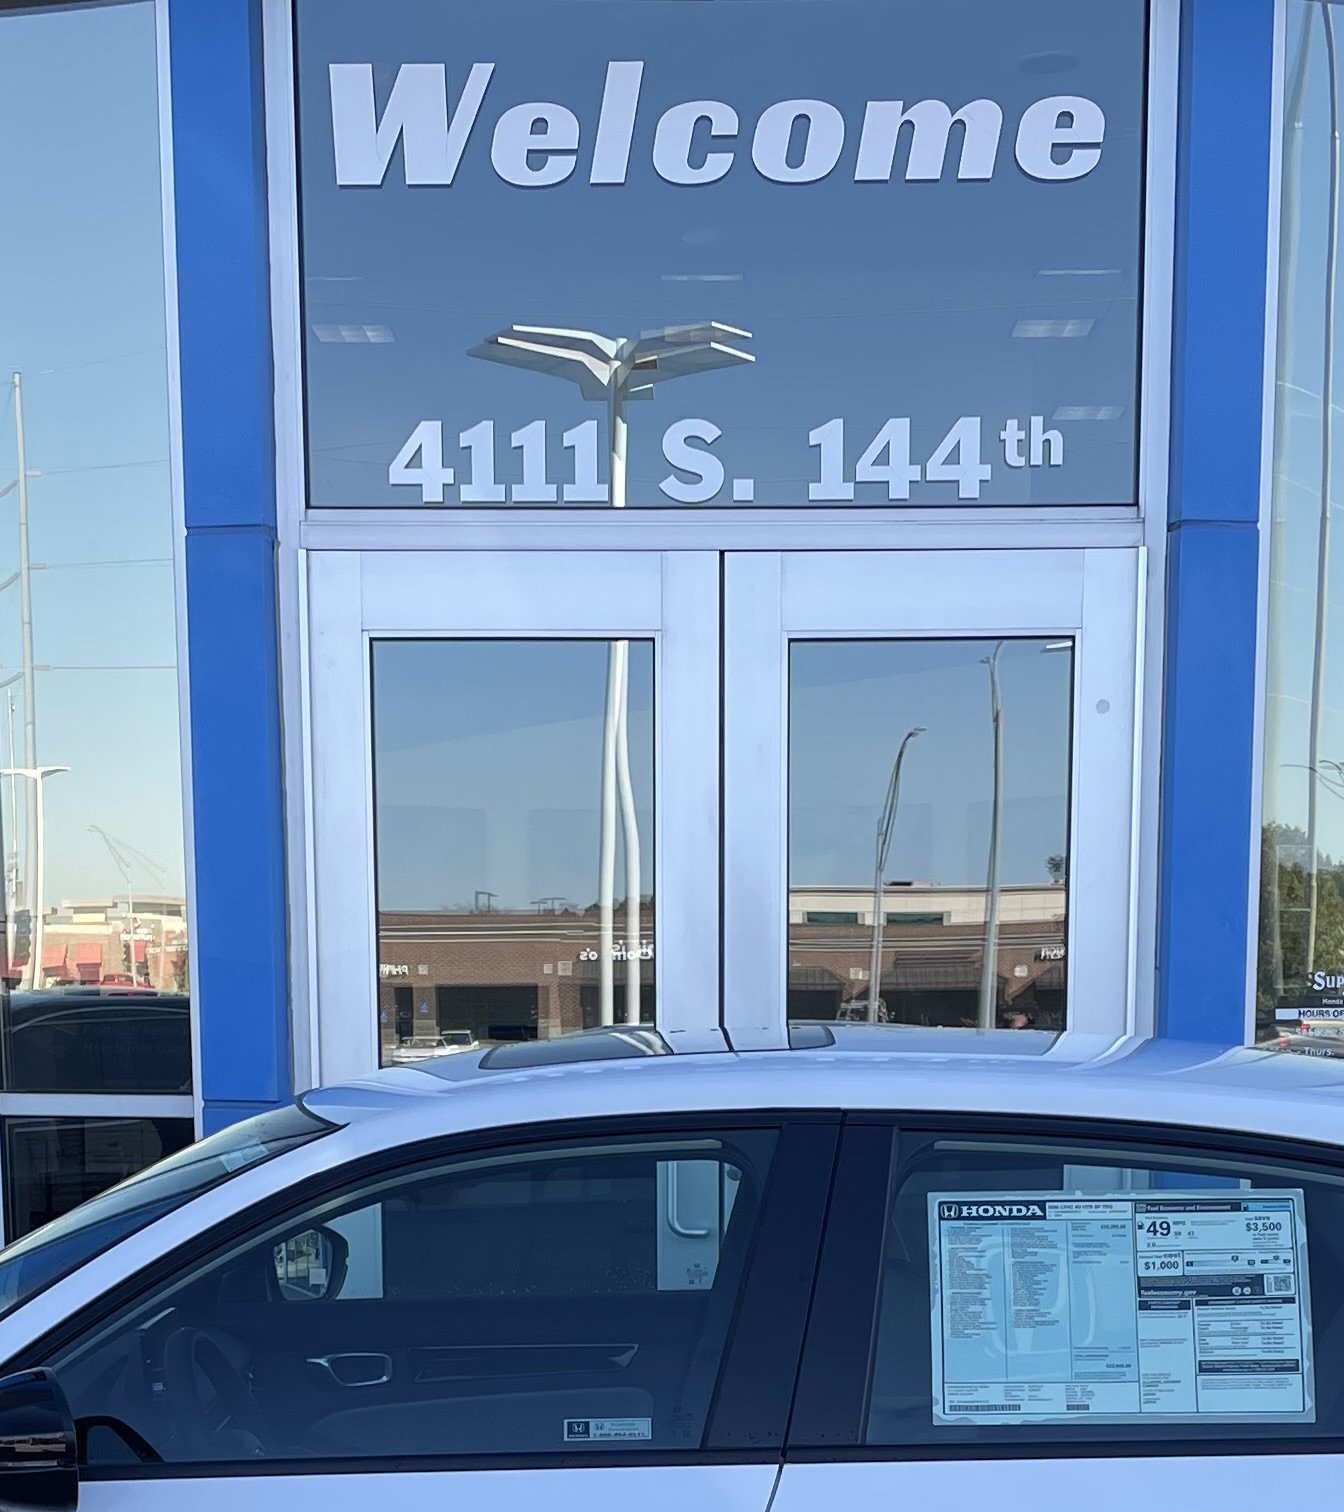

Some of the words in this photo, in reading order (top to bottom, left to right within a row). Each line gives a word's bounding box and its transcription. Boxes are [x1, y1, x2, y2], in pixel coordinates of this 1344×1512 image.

[329, 60, 1107, 187] Welcome
[388, 419, 609, 503] 4111
[658, 418, 755, 503] S.
[808, 415, 1064, 501] 144th
[1298, 1009, 1330, 1018] HOURS
[1333, 1009, 1344, 1018] OF
[960, 1205, 1044, 1217] HONDA
[1146, 1220, 1171, 1236] 49
[1245, 1222, 1282, 1232] $3,500
[1144, 1261, 1179, 1271] $1,000
